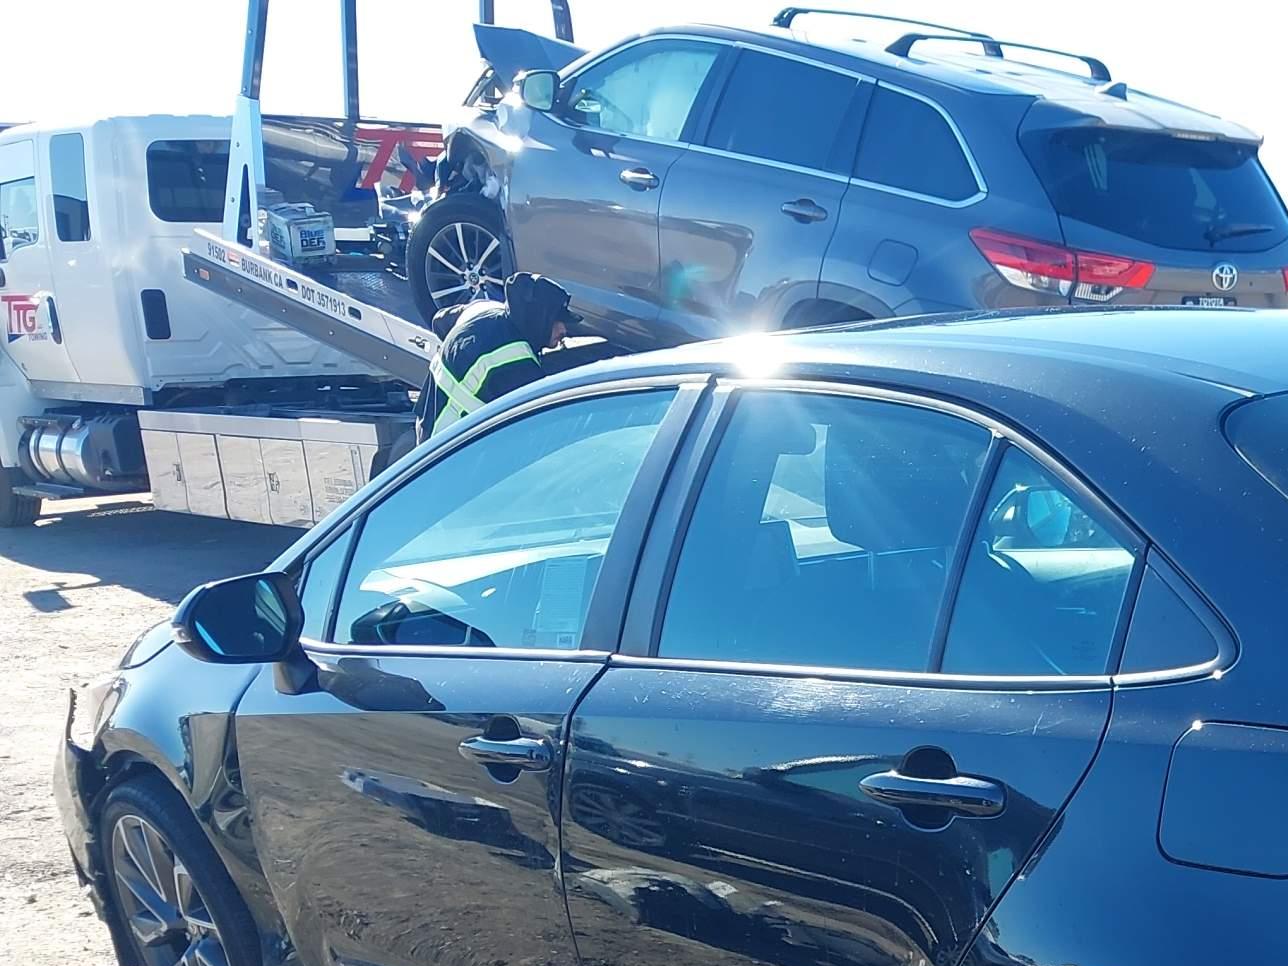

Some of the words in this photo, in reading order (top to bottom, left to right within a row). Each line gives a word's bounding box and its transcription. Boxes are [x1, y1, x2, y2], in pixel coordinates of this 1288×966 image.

[207, 242, 226, 264] 91502
[241, 257, 273, 286] BURBANK
[273, 274, 284, 289] CA
[301, 284, 316, 304] DOT
[316, 293, 347, 317] 3571913
[1199, 297, 1224, 308] TOYOTA
